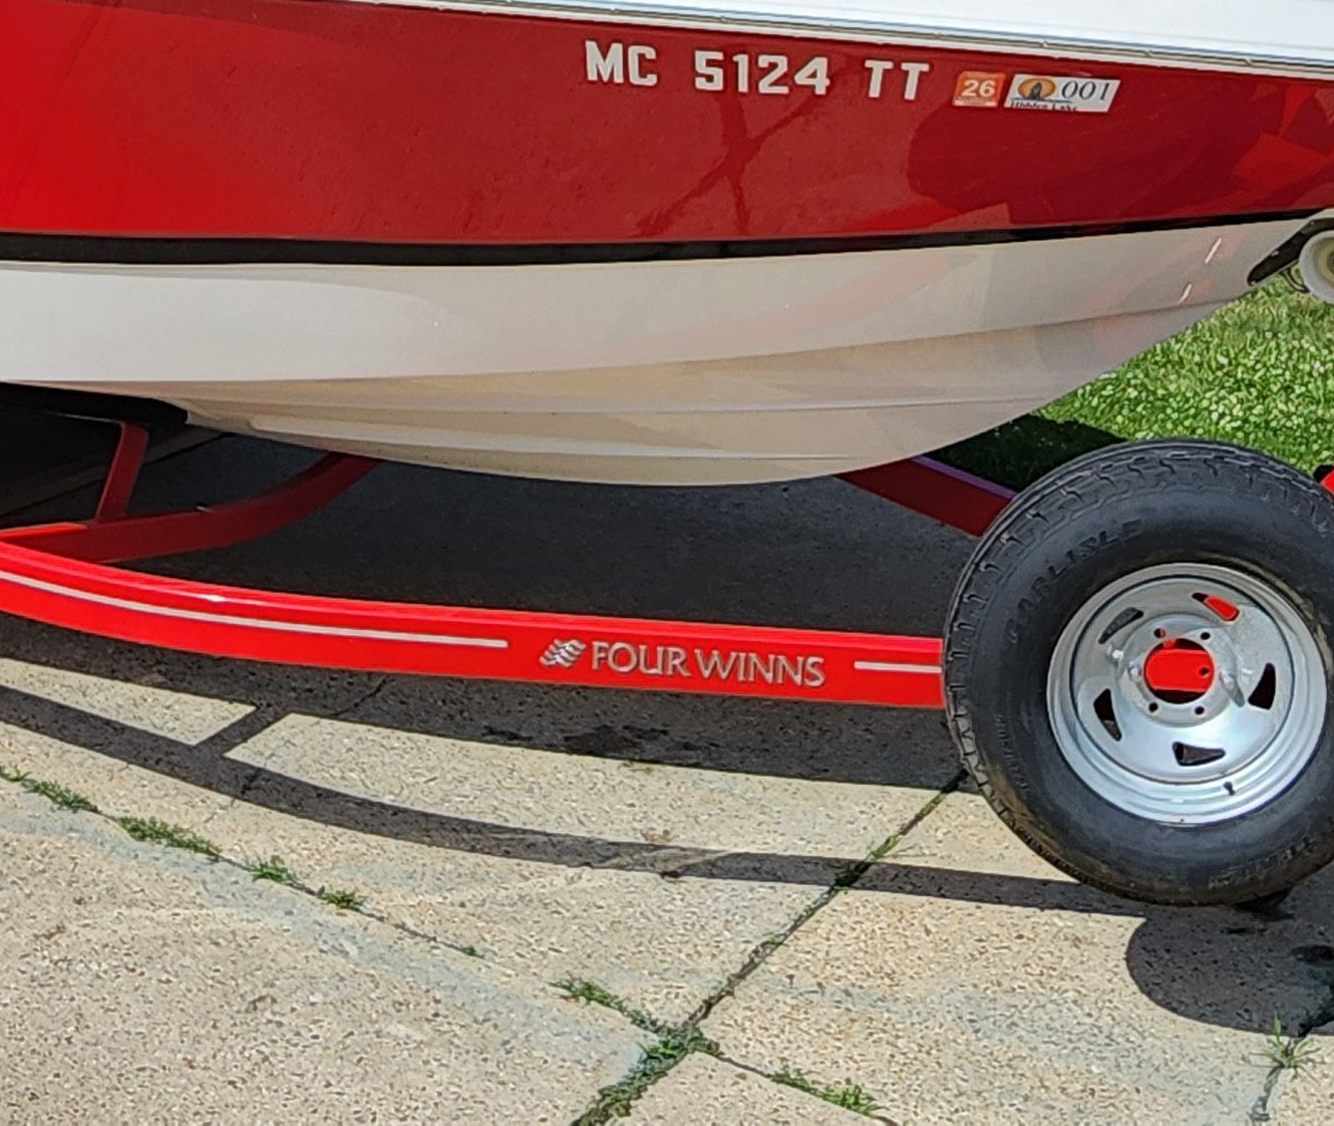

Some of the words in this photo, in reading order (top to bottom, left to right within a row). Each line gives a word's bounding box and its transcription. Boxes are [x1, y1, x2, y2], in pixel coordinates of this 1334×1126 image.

[585, 40, 657, 87] MC
[694, 49, 831, 96] 5124
[864, 59, 930, 101] TT
[961, 79, 996, 98] 26
[1061, 80, 1110, 101] 001
[591, 640, 691, 677] FOUR
[694, 648, 825, 687] WINNS
